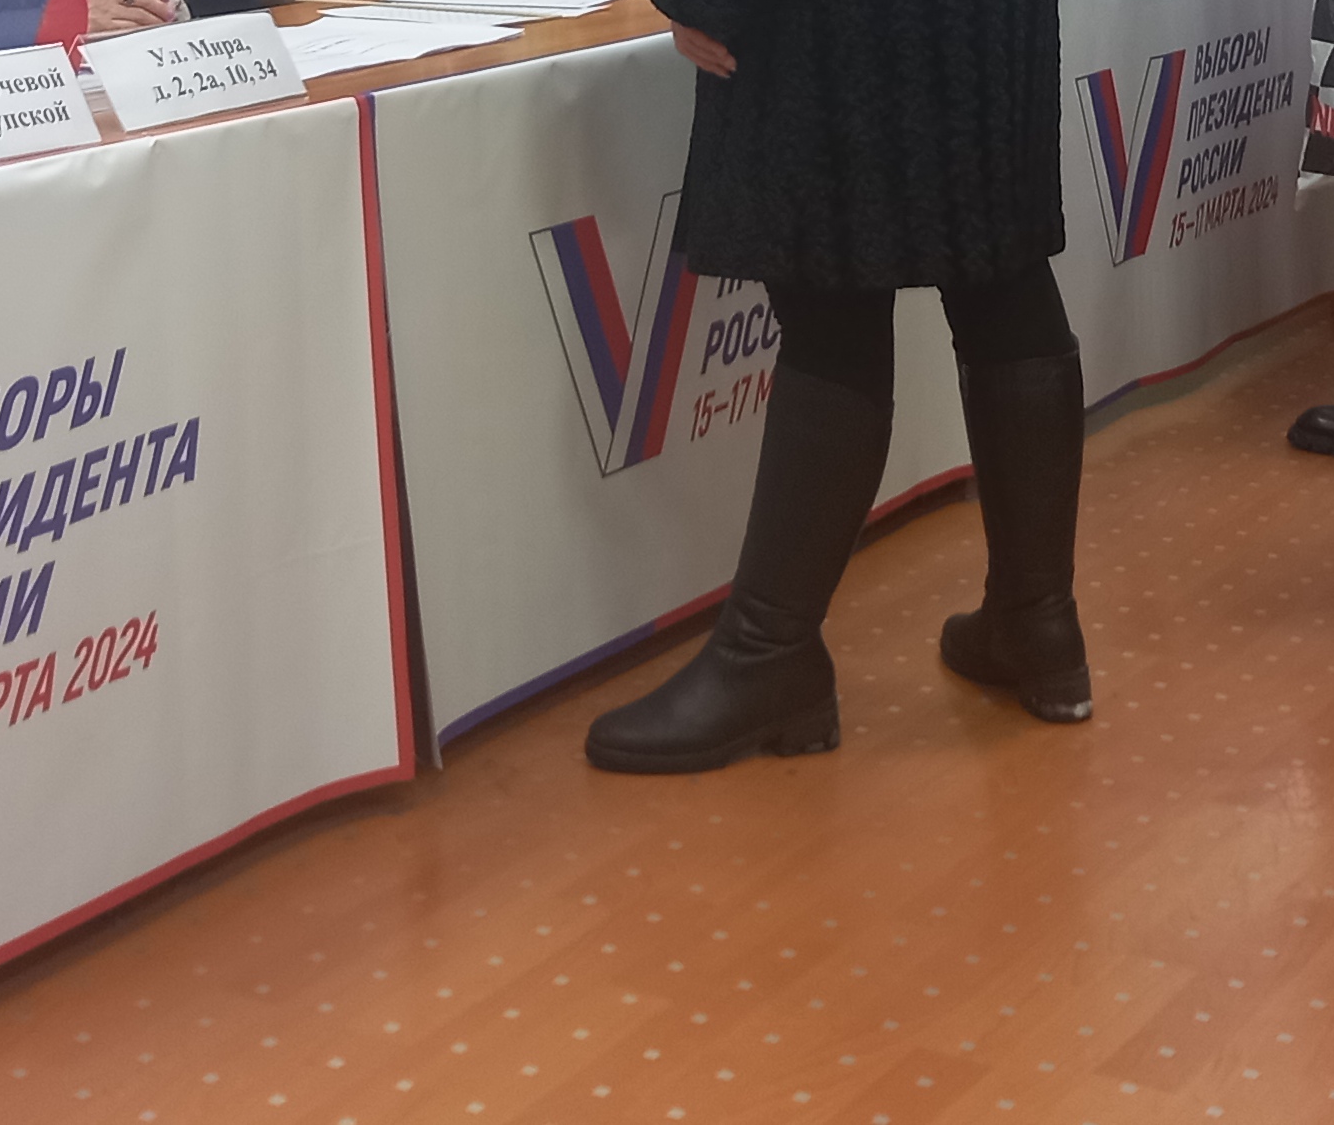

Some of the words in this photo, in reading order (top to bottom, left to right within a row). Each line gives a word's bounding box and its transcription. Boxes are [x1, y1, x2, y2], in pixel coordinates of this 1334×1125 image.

[147, 47, 189, 67] Ул.
[187, 38, 252, 59] Мира,
[153, 85, 172, 103] д.
[172, 76, 195, 98] 2,
[193, 71, 226, 91] 2а,
[225, 63, 256, 86] 10,
[254, 58, 278, 80] 34
[1194, 26, 1271, 85] ВЫБОРЫ
[1186, 71, 1294, 142] ПРЕЗИДЕНТА
[1177, 136, 1248, 199] РОССИИ
[1247, 176, 1279, 216] 2024
[700, 302, 782, 375] РОСС
[61, 610, 159, 704] 2024
